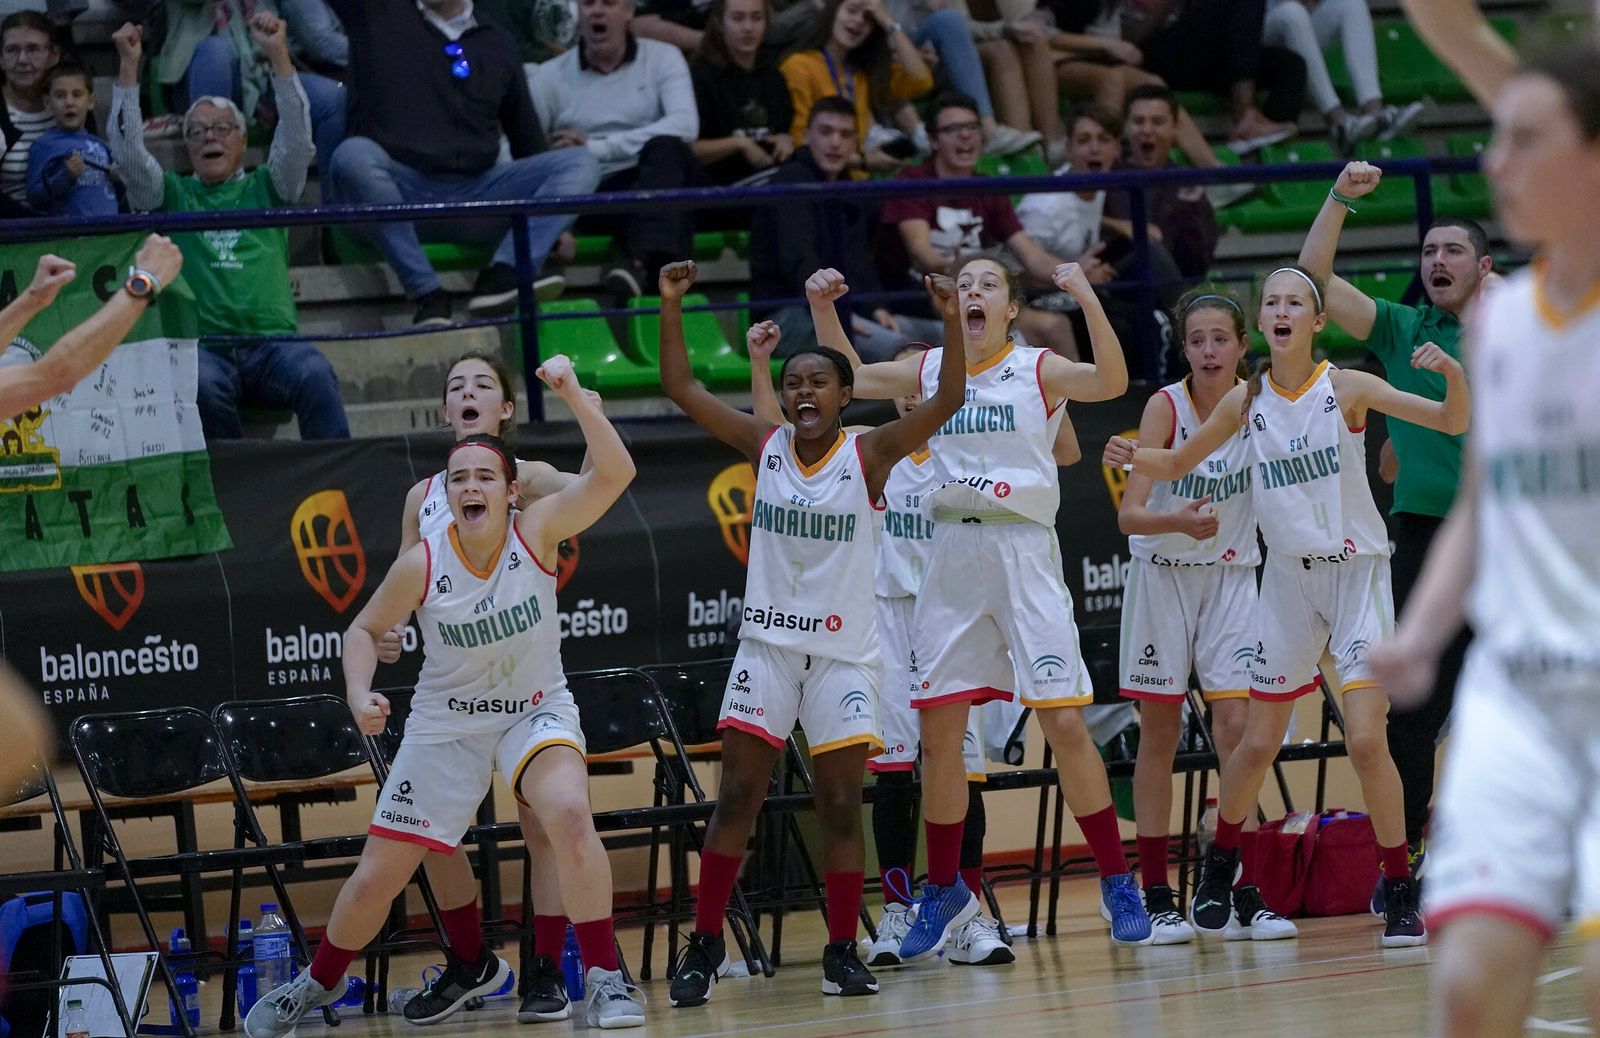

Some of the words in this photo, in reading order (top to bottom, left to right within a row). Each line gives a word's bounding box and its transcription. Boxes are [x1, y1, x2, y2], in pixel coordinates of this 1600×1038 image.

[965, 388, 978, 402] OY
[1290, 434, 1309, 452] SOY
[1208, 459, 1228, 473] SOY
[1258, 444, 1340, 490] ANDALUC
[906, 494, 920, 508] SO
[752, 499, 856, 543] ANDALUCIA
[437, 594, 542, 649] ANDALUCIA
[743, 606, 823, 633] cajasur
[268, 664, 332, 686] ESPAÑA
[1129, 673, 1168, 686] cajasur
[44, 685, 110, 705] ESPAÑA
[391, 793, 414, 806] CIPA
[380, 810, 422, 826] cajasur
